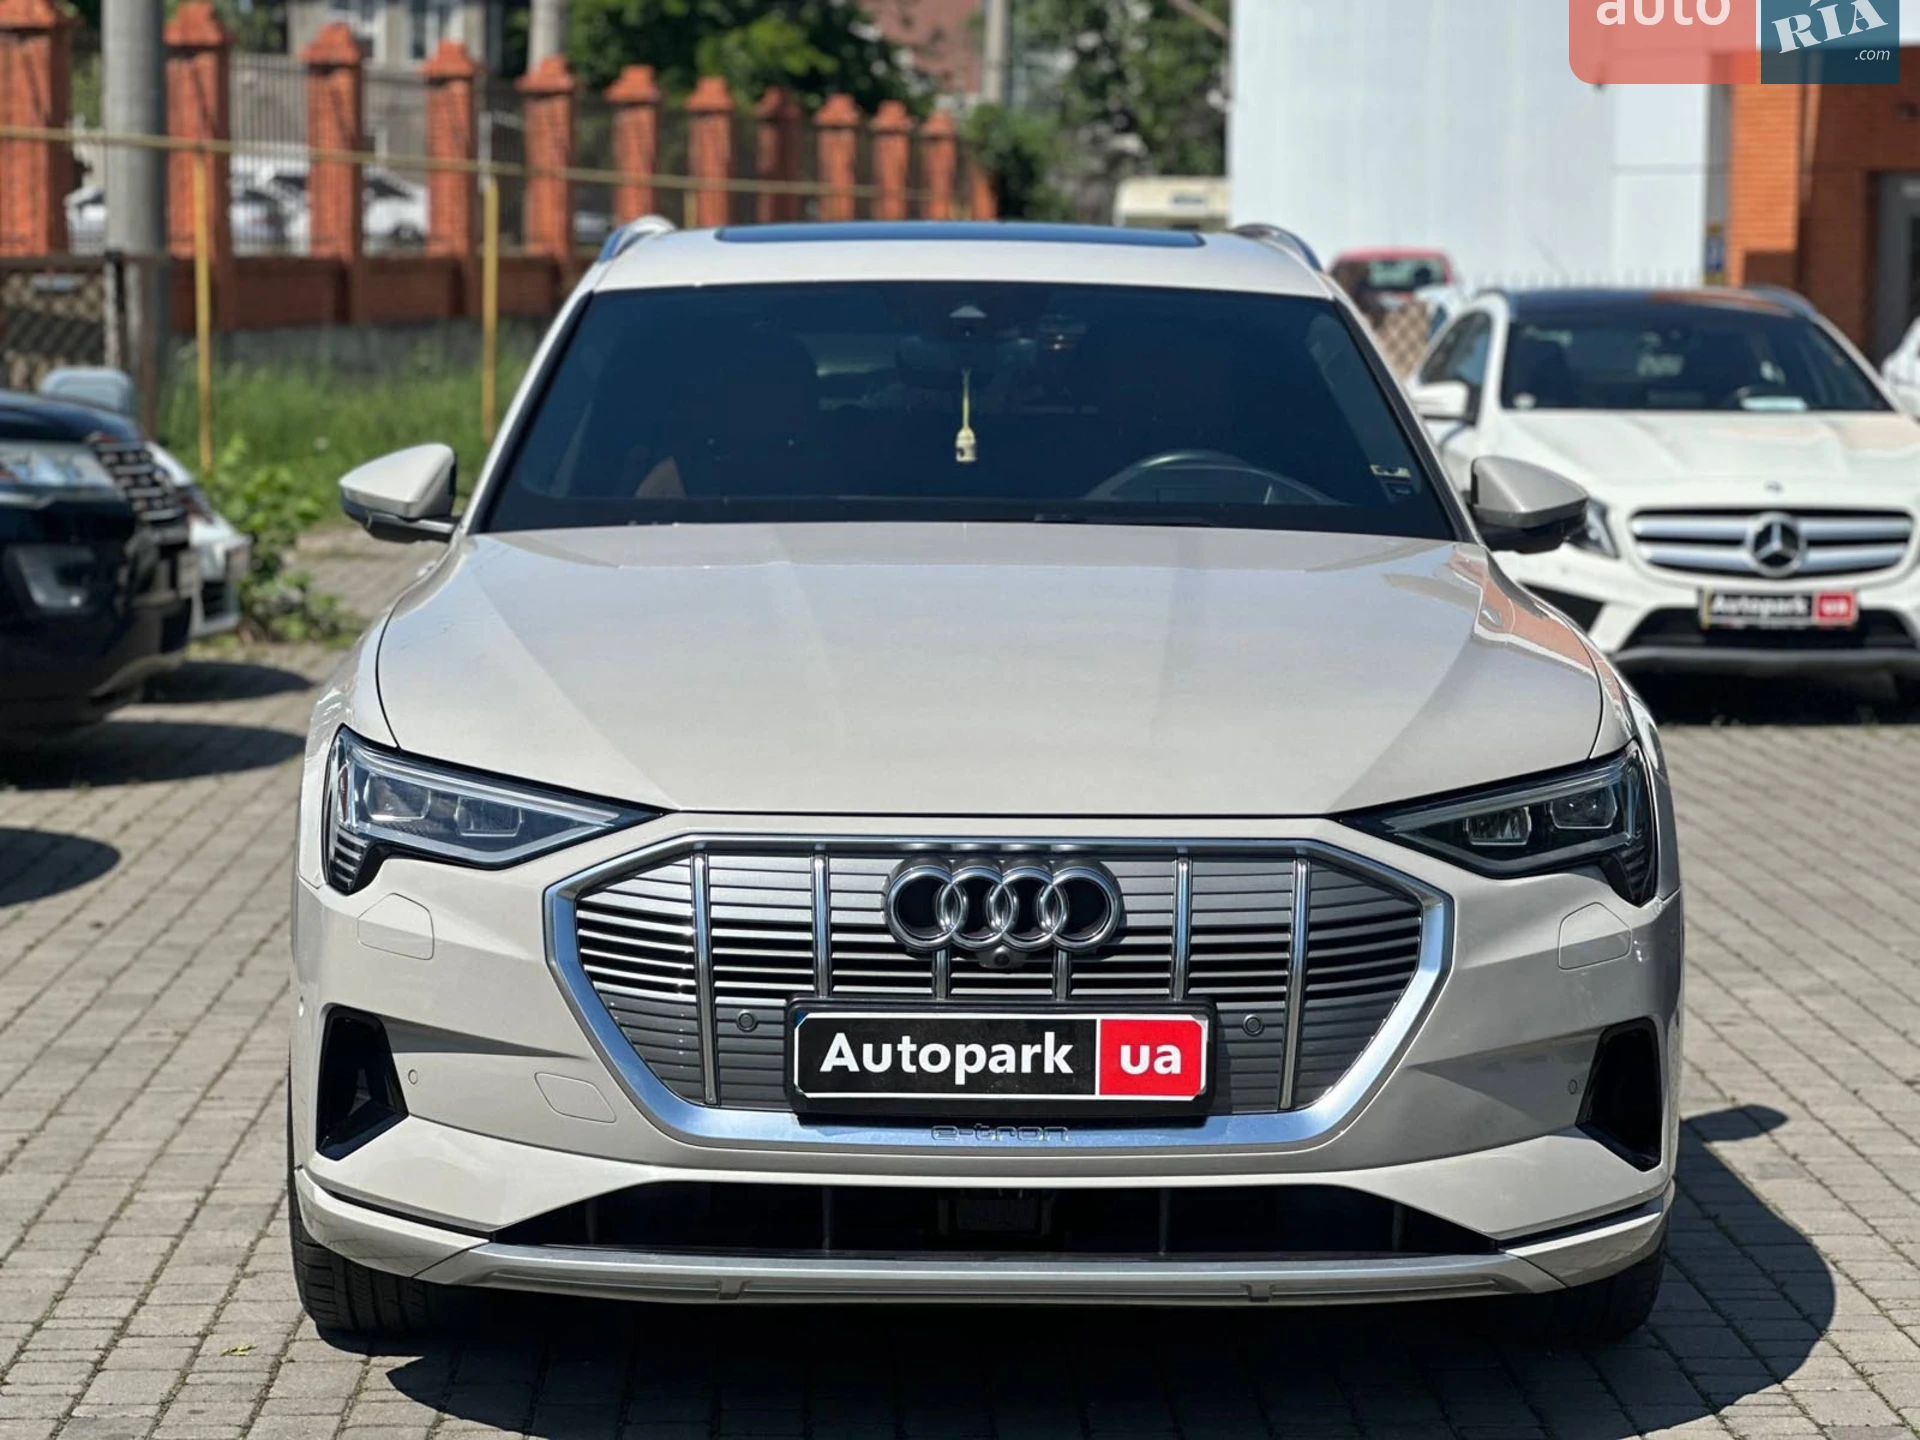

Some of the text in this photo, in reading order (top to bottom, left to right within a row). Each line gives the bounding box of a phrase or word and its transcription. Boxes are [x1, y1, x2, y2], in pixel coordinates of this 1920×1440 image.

[819, 1031, 1182, 1085] Autopark ua
[930, 1123, 1069, 1141] e-tron
